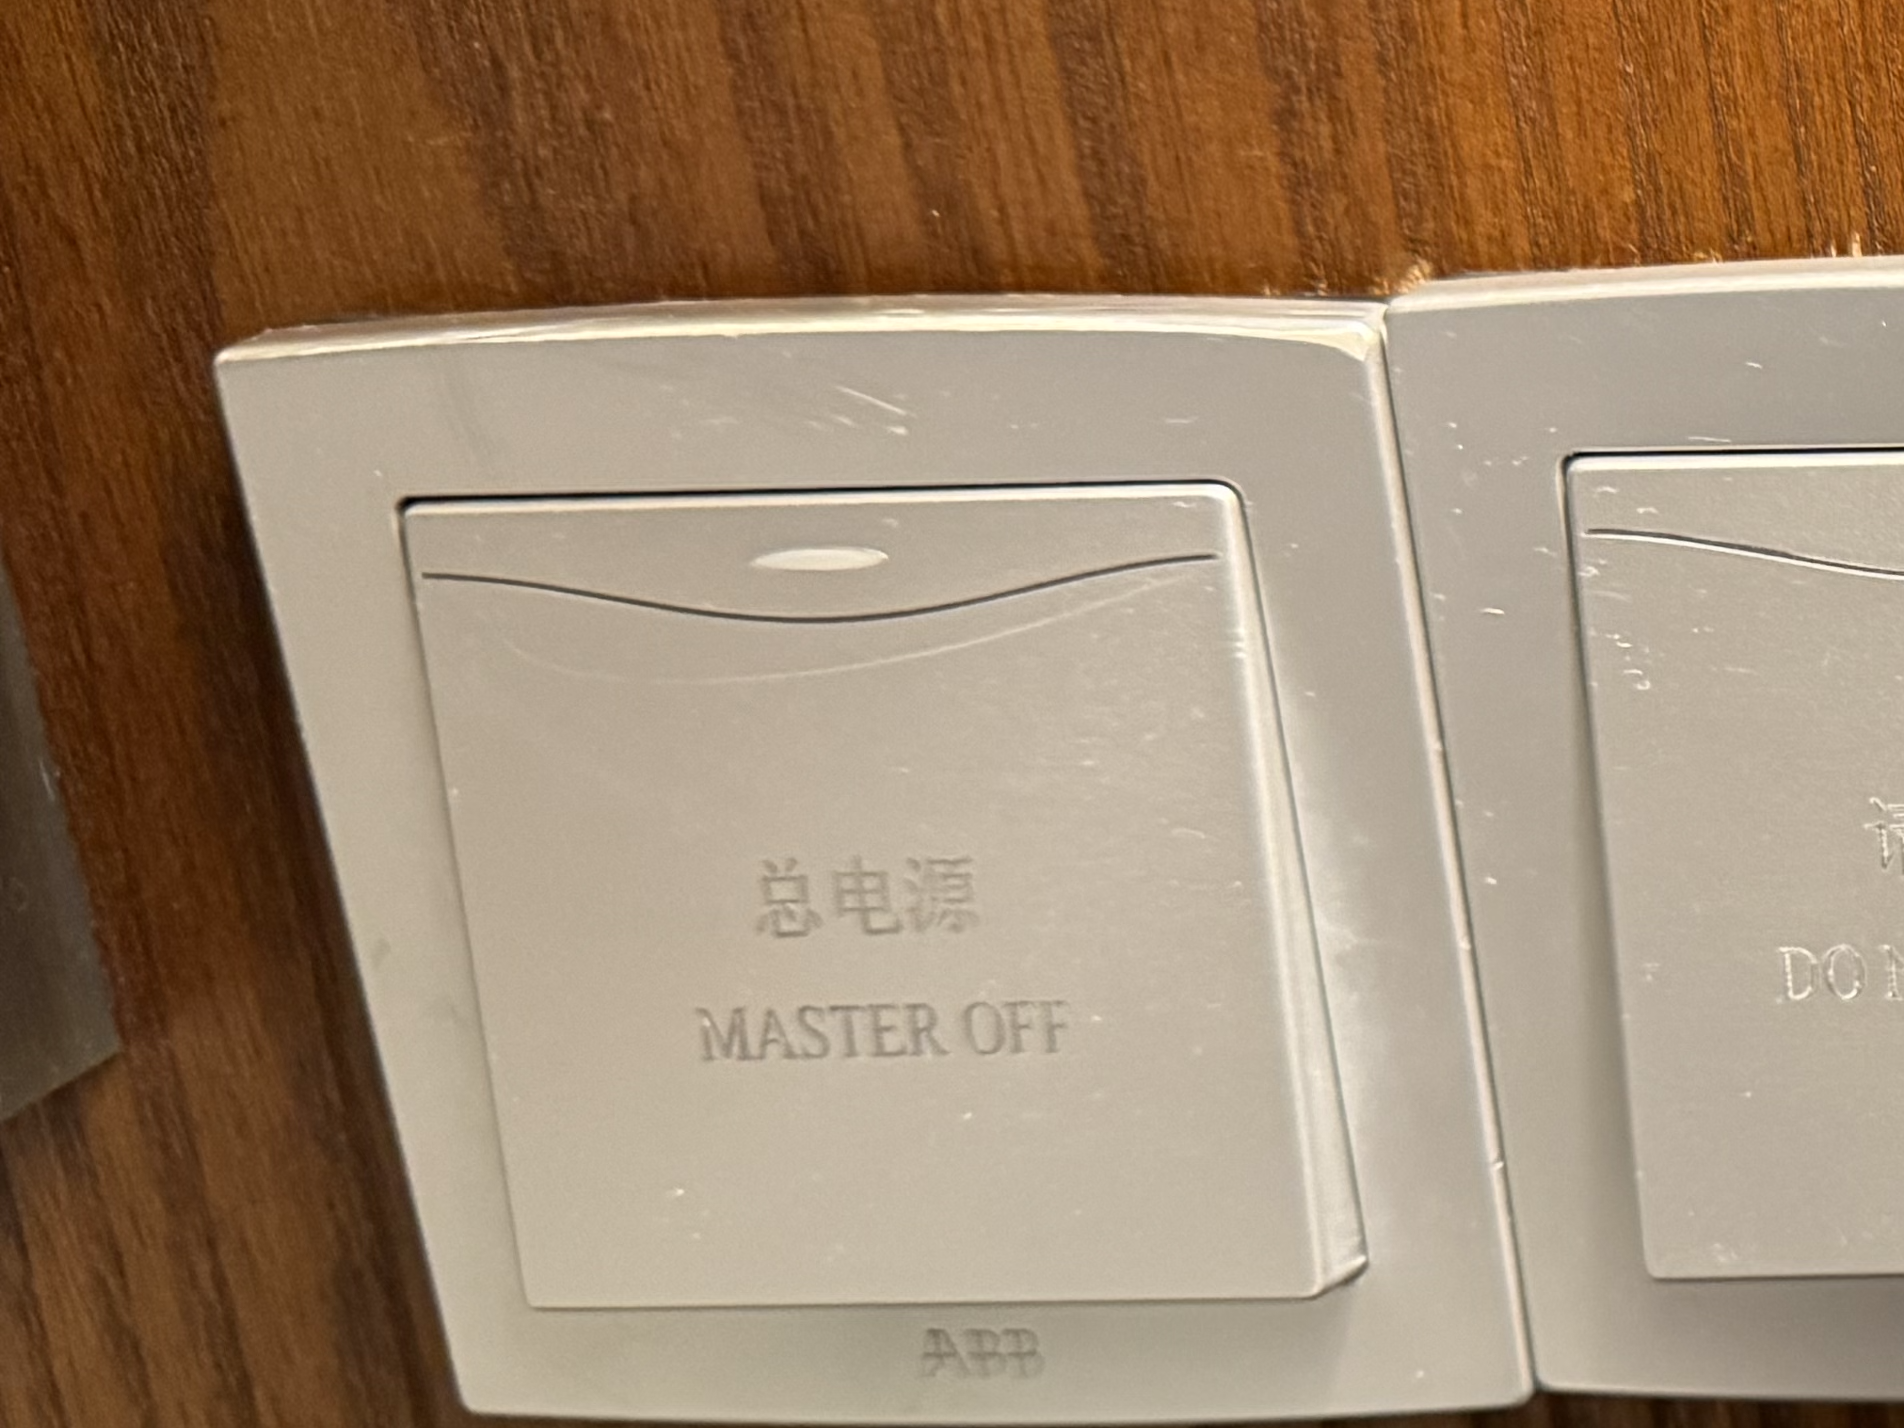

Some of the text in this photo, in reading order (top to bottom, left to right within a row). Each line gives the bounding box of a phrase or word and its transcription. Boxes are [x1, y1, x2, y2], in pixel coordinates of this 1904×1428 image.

[754, 856, 979, 938] 总电源
[1778, 944, 1868, 1001] DO
[697, 1000, 1069, 1061] MASTER OFF
[919, 1326, 1044, 1378] ABB
